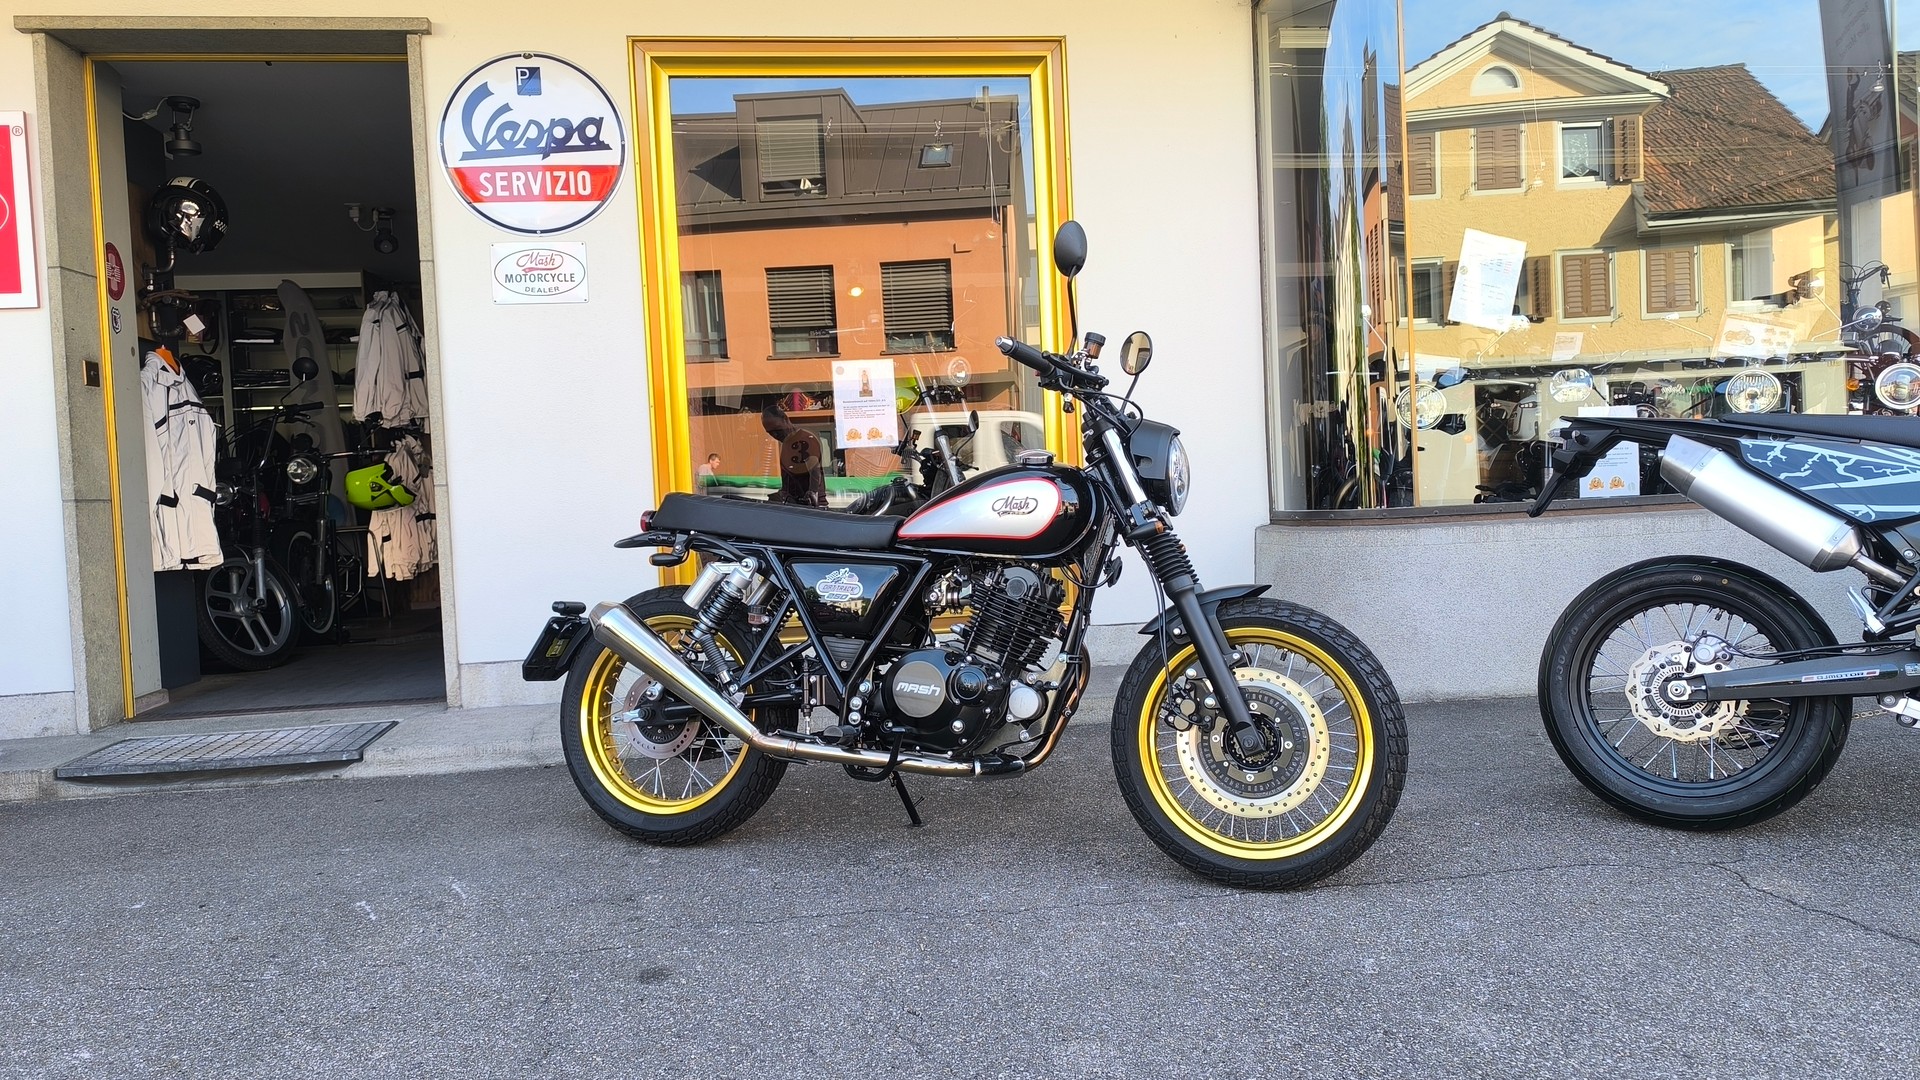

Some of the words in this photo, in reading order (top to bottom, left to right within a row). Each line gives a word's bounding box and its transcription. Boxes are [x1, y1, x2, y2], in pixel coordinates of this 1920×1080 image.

[517, 68, 530, 86] P
[458, 80, 614, 161] Vespa
[479, 170, 593, 197] SERVIZIO
[504, 272, 576, 284] MOTORCYCLE
[524, 286, 561, 294] DEALER
